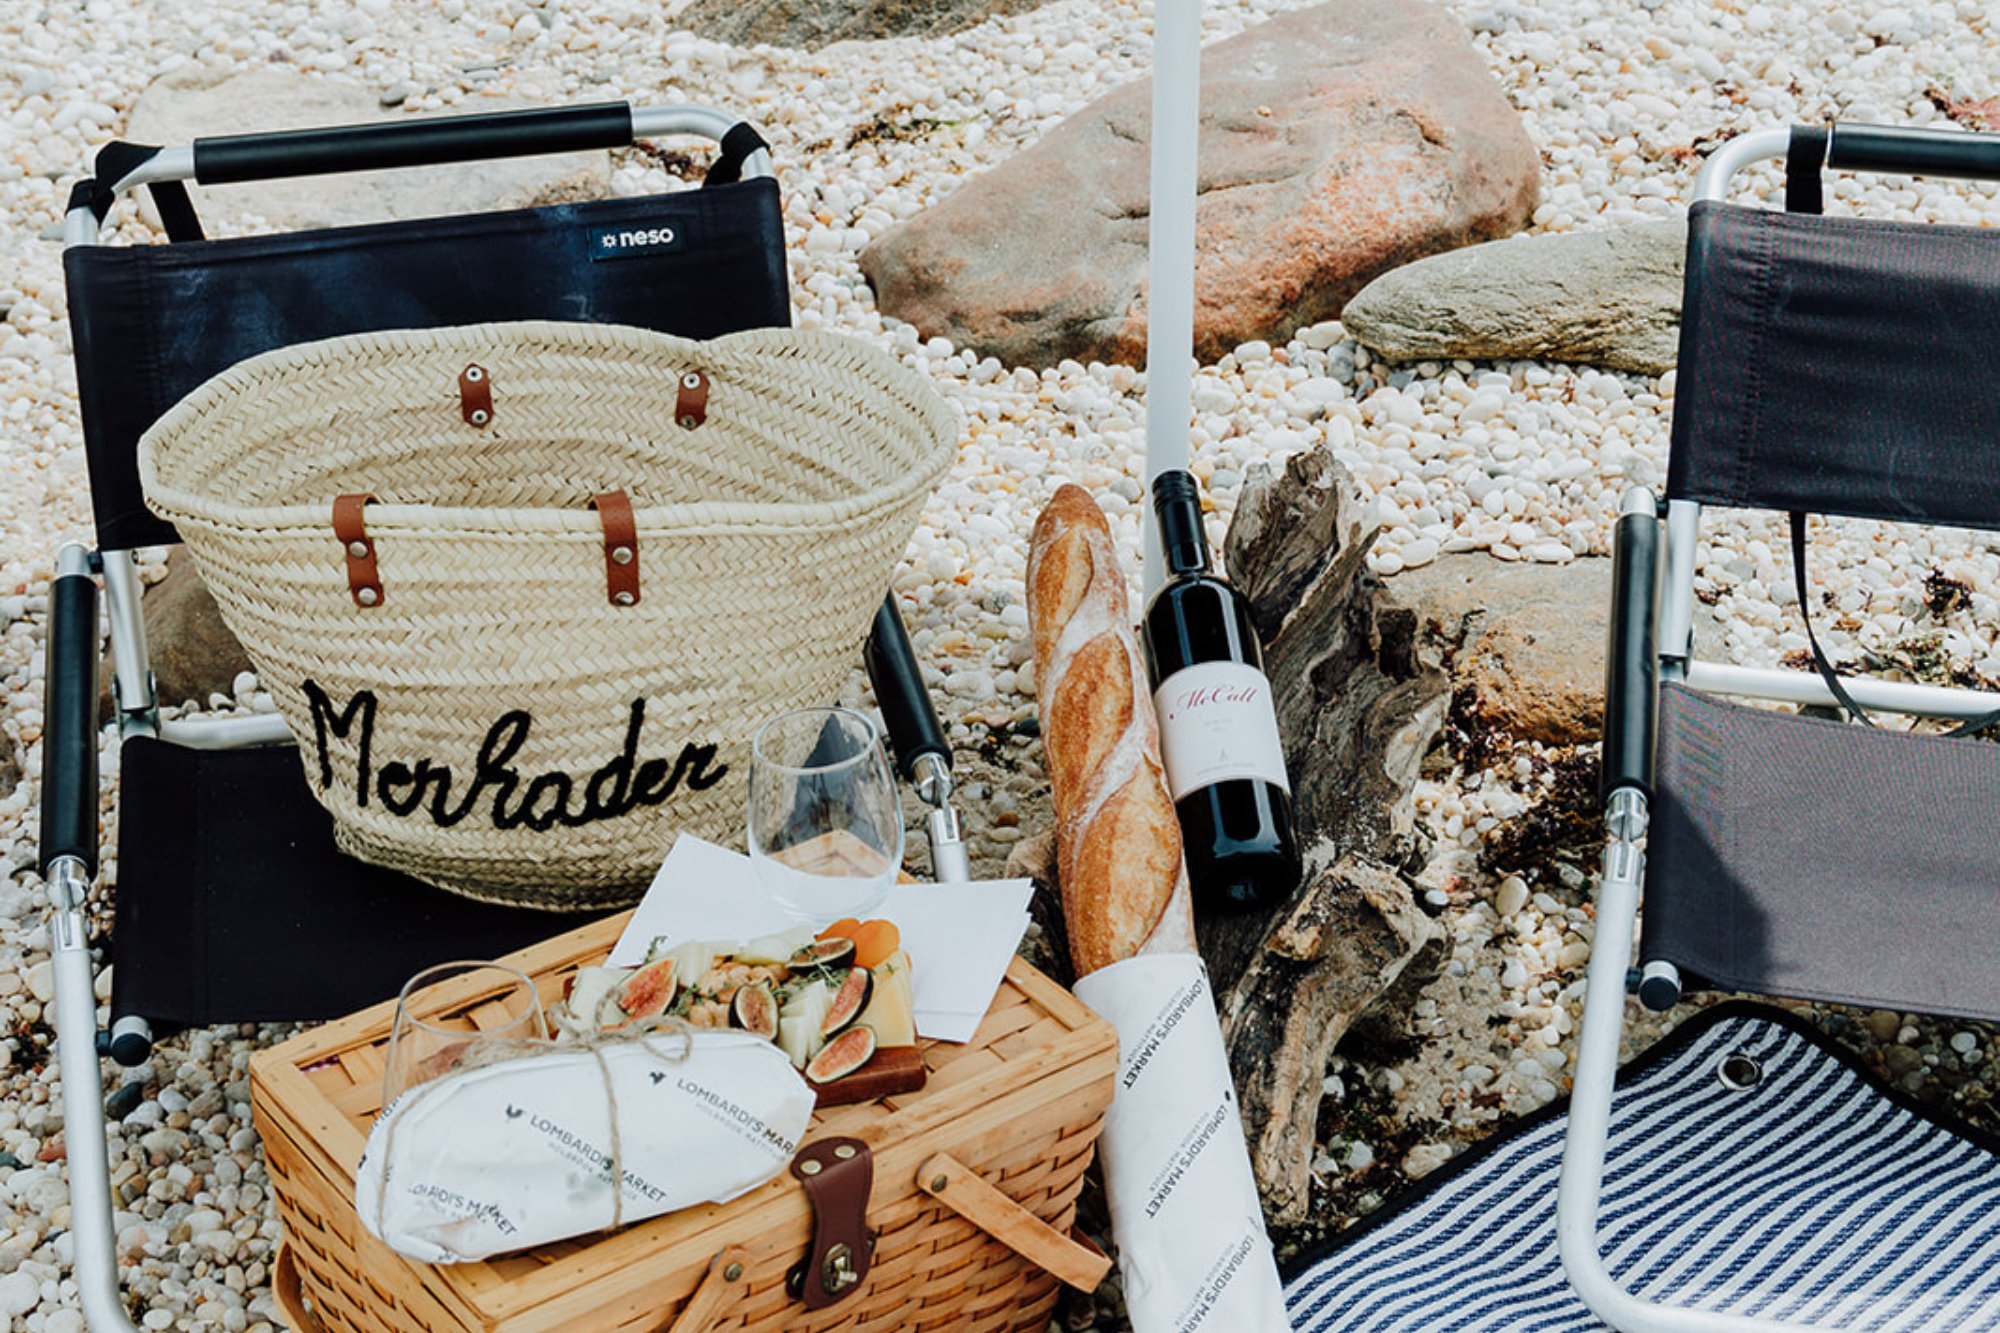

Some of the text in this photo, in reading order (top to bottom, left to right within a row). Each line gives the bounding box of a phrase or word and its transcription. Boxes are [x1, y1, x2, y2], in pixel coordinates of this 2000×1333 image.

[619, 228, 674, 247] neso
[1170, 684, 1258, 714] McCall
[1123, 1038, 1161, 1090] MARKET
[677, 1078, 796, 1155] LOMBARDI'S MAR
[1145, 1104, 1229, 1219] LOMBARDI'S MARKET
[1205, 1235, 1255, 1304] LOMBARDI'S
